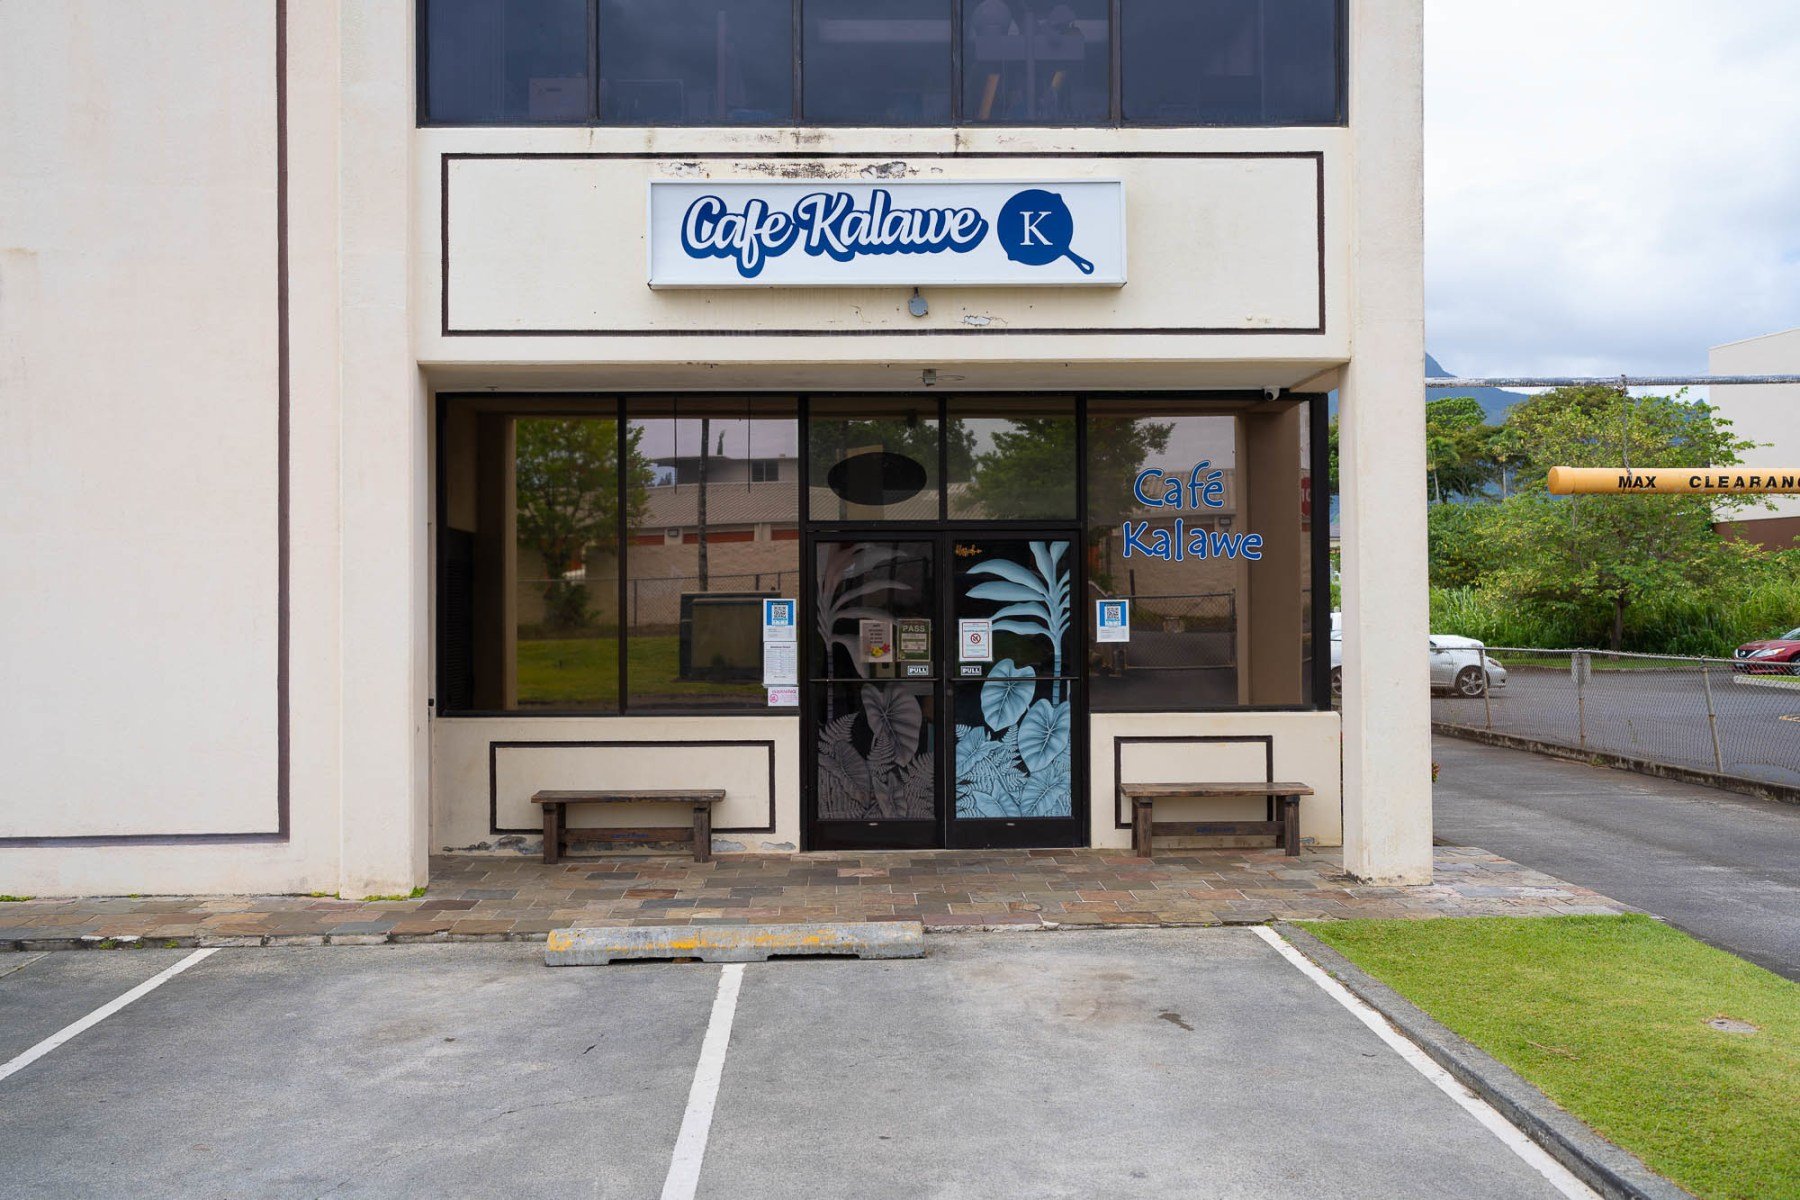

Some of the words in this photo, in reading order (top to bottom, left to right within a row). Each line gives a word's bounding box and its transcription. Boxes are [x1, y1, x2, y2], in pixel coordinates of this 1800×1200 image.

[681, 195, 800, 278] Cafe
[797, 189, 988, 262] Kalawe
[1019, 210, 1053, 246] K
[1133, 460, 1224, 510] Café
[1618, 475, 1657, 489] MAX
[1689, 475, 1800, 489] CLEARAN
[1123, 518, 1264, 562] Kalawe
